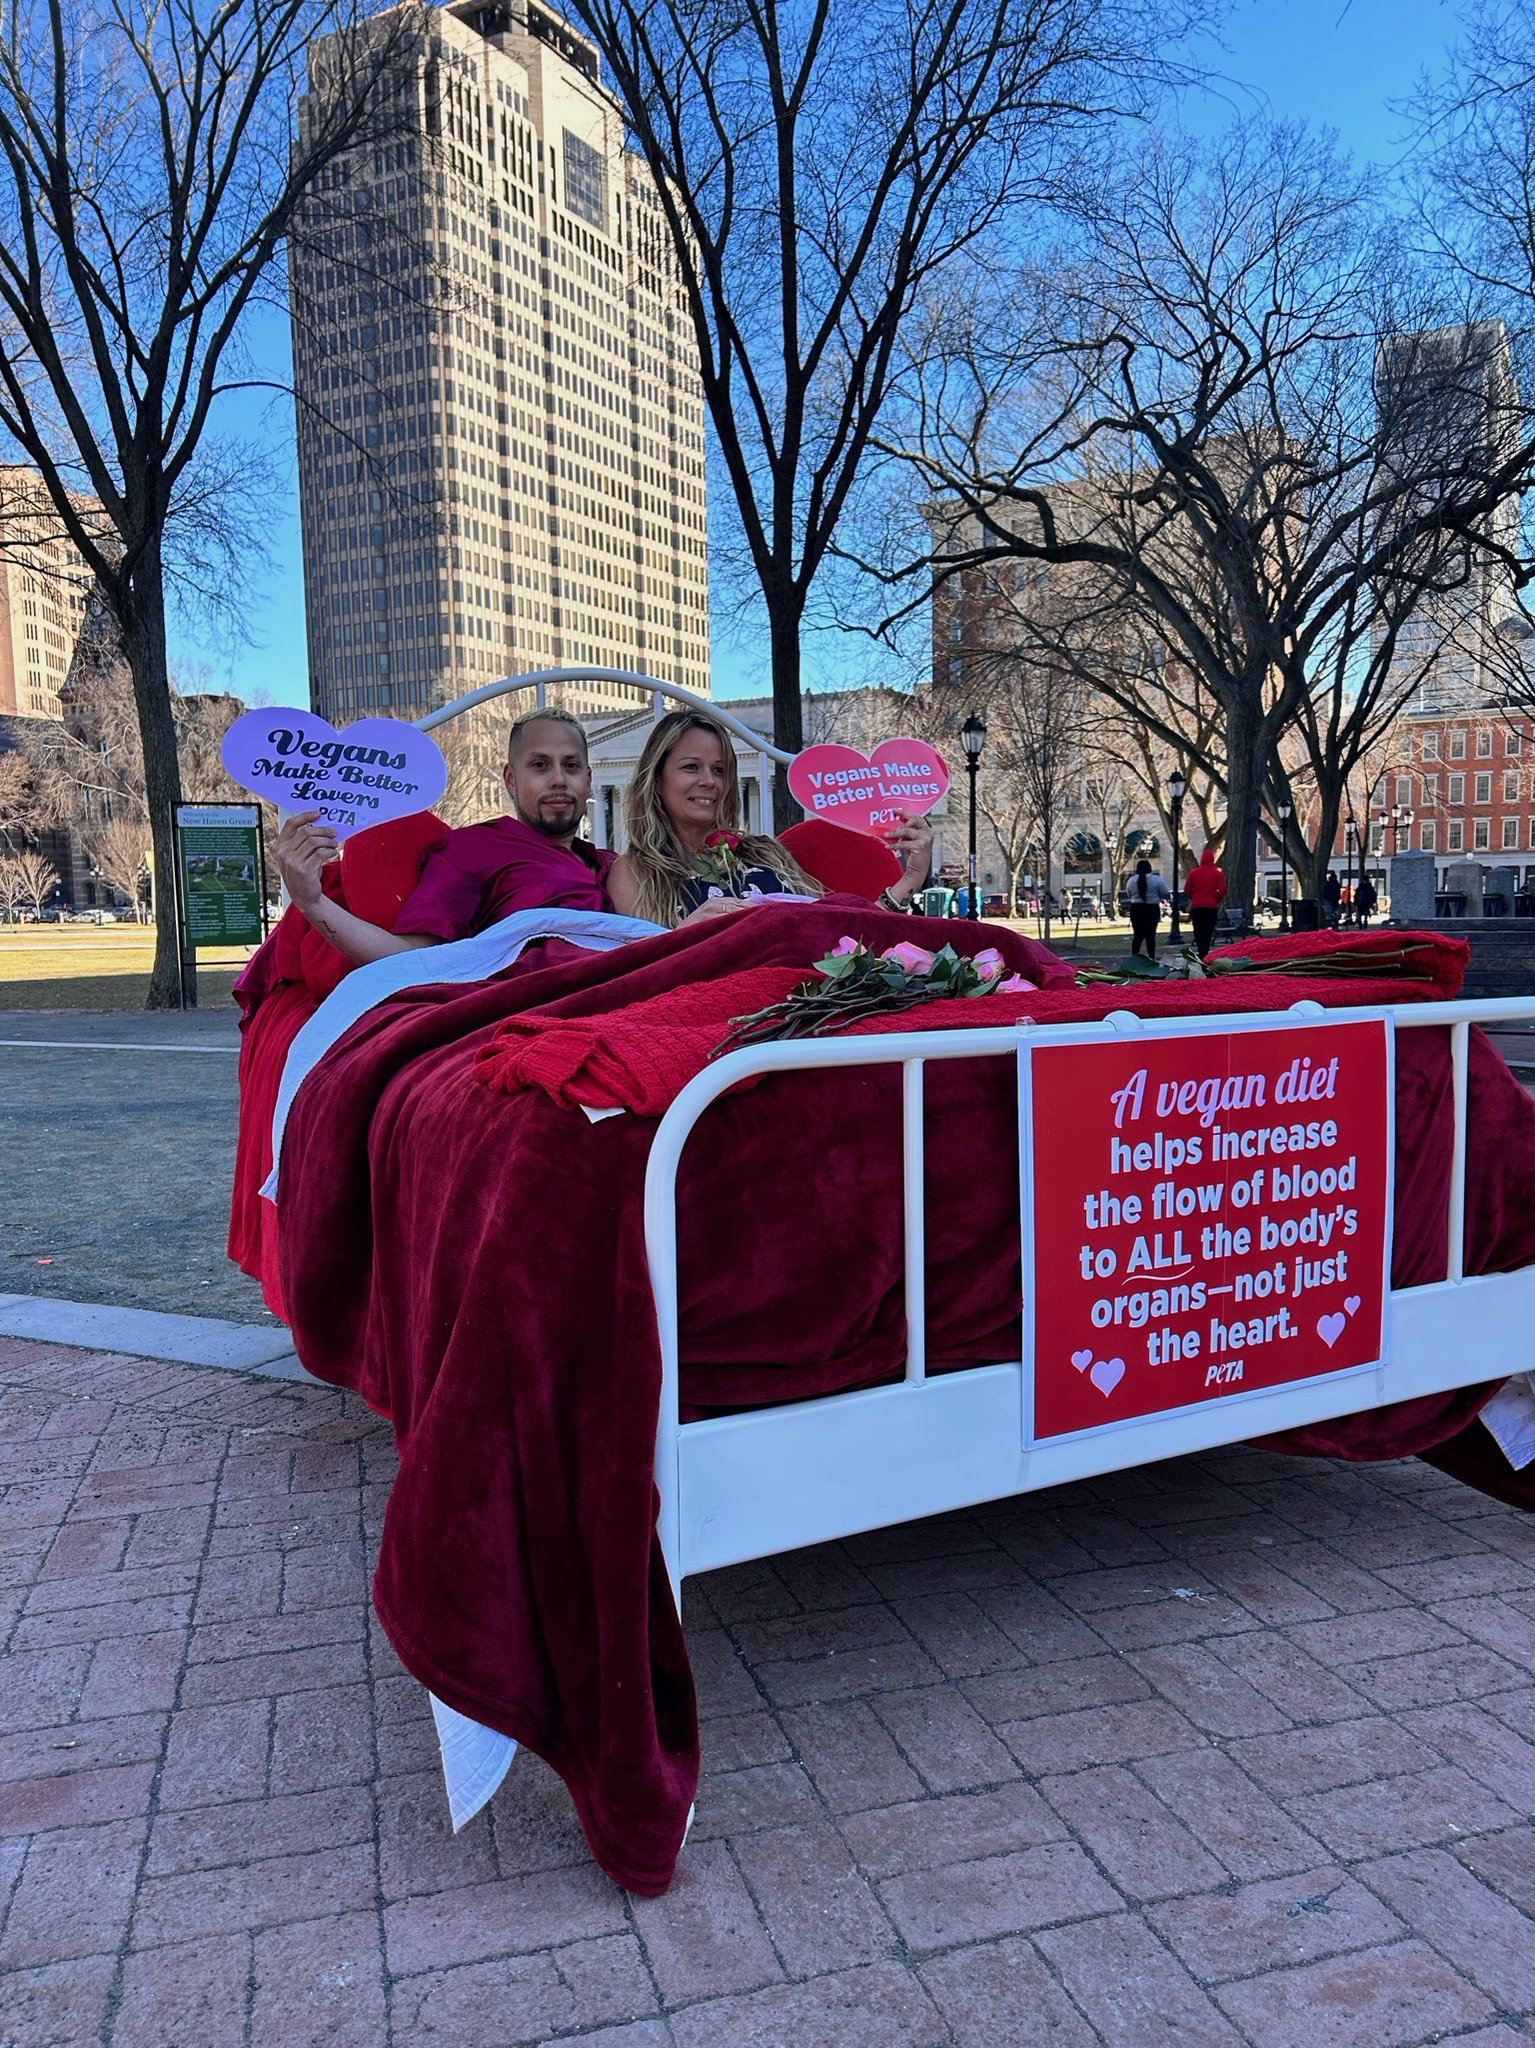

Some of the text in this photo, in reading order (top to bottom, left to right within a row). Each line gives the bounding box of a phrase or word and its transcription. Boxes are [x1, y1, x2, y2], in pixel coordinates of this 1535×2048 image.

[267, 729, 407, 770] Vegans
[251, 758, 419, 795] Make Better
[290, 781, 380, 809] Lovers
[807, 762, 932, 788] Vegans Make
[812, 782, 940, 810] Better Lovers
[183, 817, 253, 825] New Haven Green
[1110, 1056, 1340, 1128] A vegan diet
[1110, 1119, 1338, 1175] helps increase
[1084, 1156, 1356, 1229] the flow of blood
[1079, 1204, 1358, 1280] to ALL the body’s
[1291, 1250, 1348, 1297] just
[1146, 1307, 1298, 1366] the heart.
